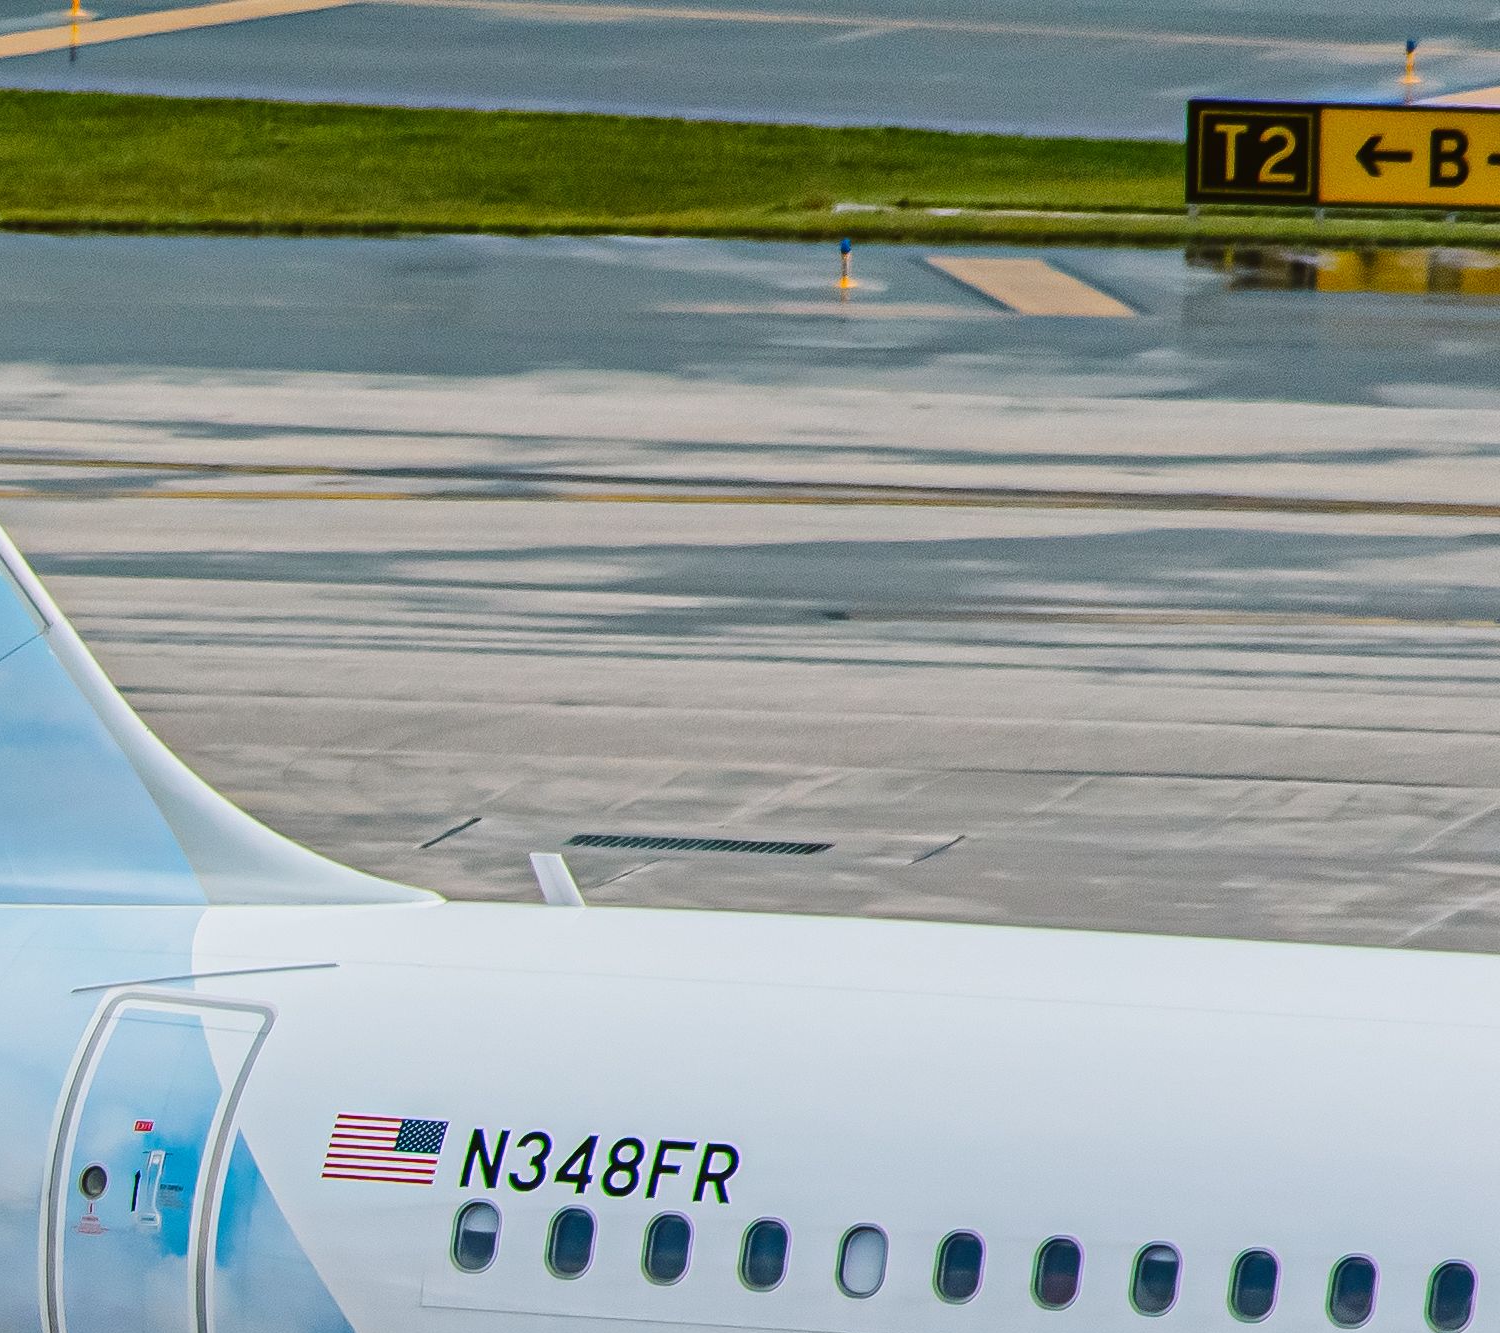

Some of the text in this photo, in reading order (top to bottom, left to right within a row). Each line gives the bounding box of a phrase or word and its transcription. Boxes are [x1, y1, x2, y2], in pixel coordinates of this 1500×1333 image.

[1214, 123, 1471, 188] T2 B
[461, 1129, 740, 1204] N348FR
